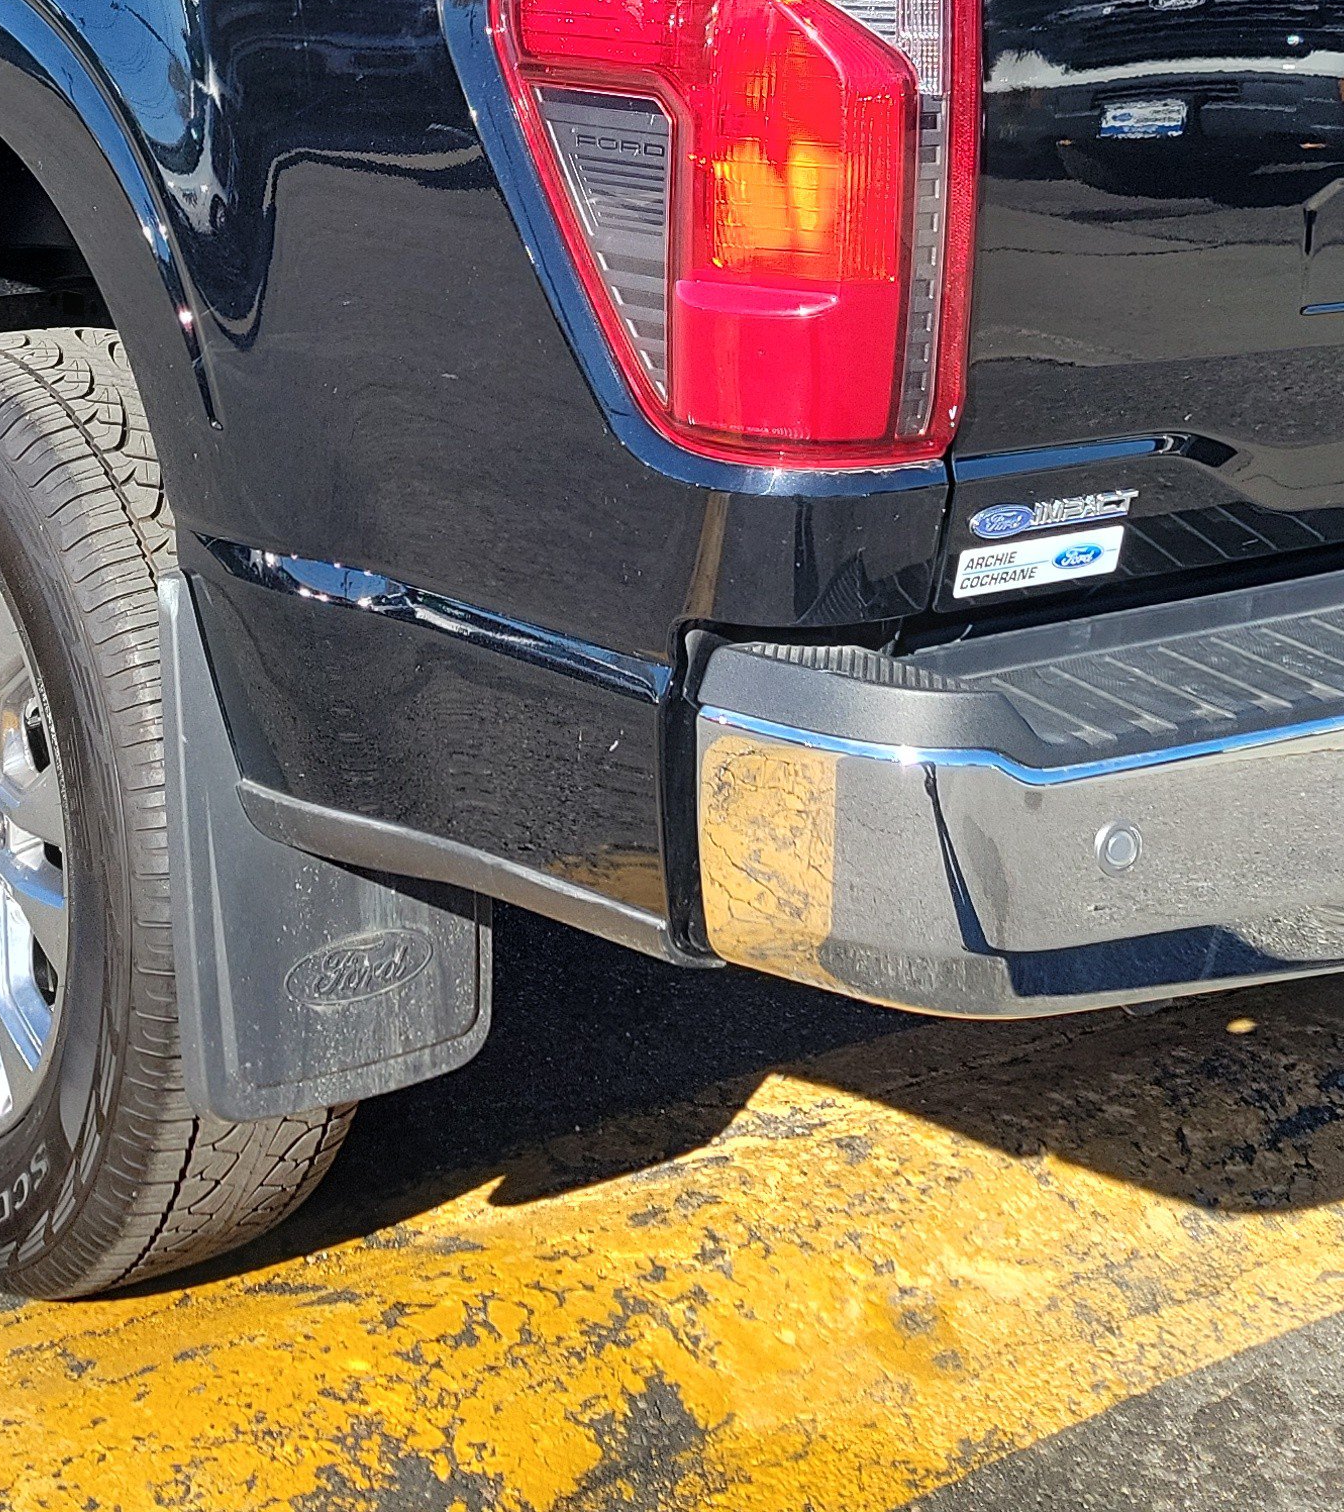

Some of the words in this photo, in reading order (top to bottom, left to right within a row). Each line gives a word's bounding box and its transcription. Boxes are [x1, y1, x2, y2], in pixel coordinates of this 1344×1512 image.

[576, 133, 665, 158] FORD
[985, 510, 1023, 532] Ford
[1031, 488, 1140, 526] IMPACT
[964, 550, 1018, 572] ARCHIE
[1060, 544, 1096, 566] Ford
[959, 566, 1039, 590] COCHRANE
[311, 938, 409, 995] Ford
